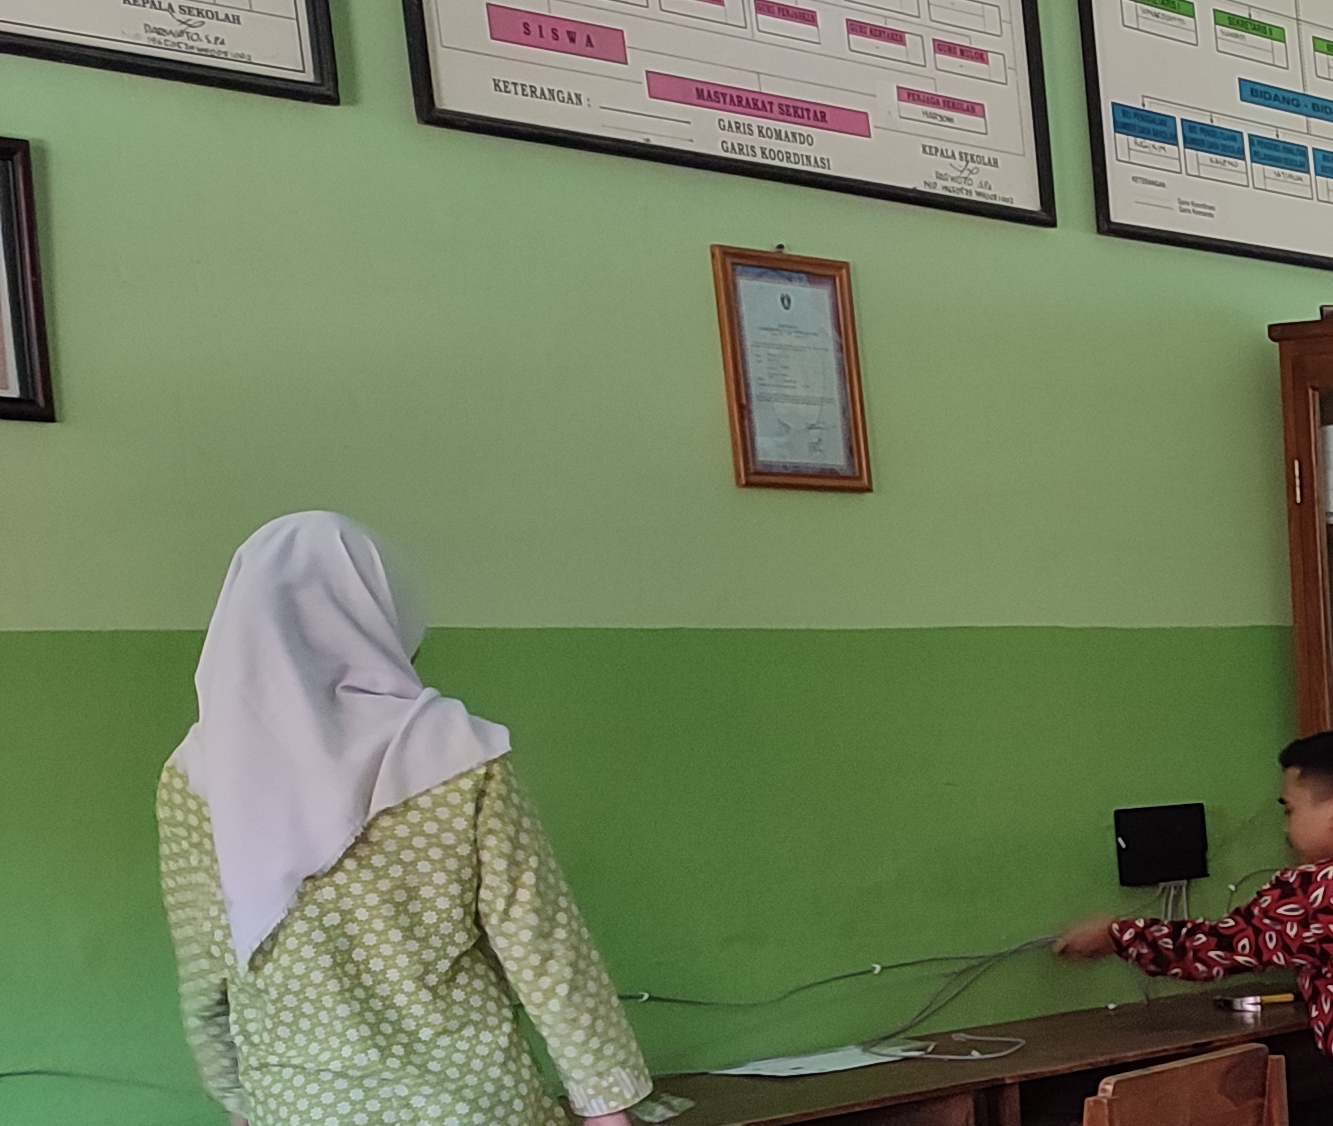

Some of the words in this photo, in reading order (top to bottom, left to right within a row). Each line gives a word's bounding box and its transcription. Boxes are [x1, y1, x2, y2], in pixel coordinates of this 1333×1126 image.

[178, 4, 242, 25] SEKOLAH
[492, 78, 583, 106] KETERANGAN
[695, 86, 776, 114] MASYARAKAT
[777, 103, 829, 124] SEKITAR
[1249, 87, 1301, 108] BIDANG
[717, 118, 755, 135] GARIS
[756, 124, 815, 147] KOMANDO
[720, 140, 758, 158] GARIS
[759, 146, 832, 170] KOORDINASI
[921, 144, 957, 161] KEPALA
[958, 151, 999, 168] SEKOLAH
